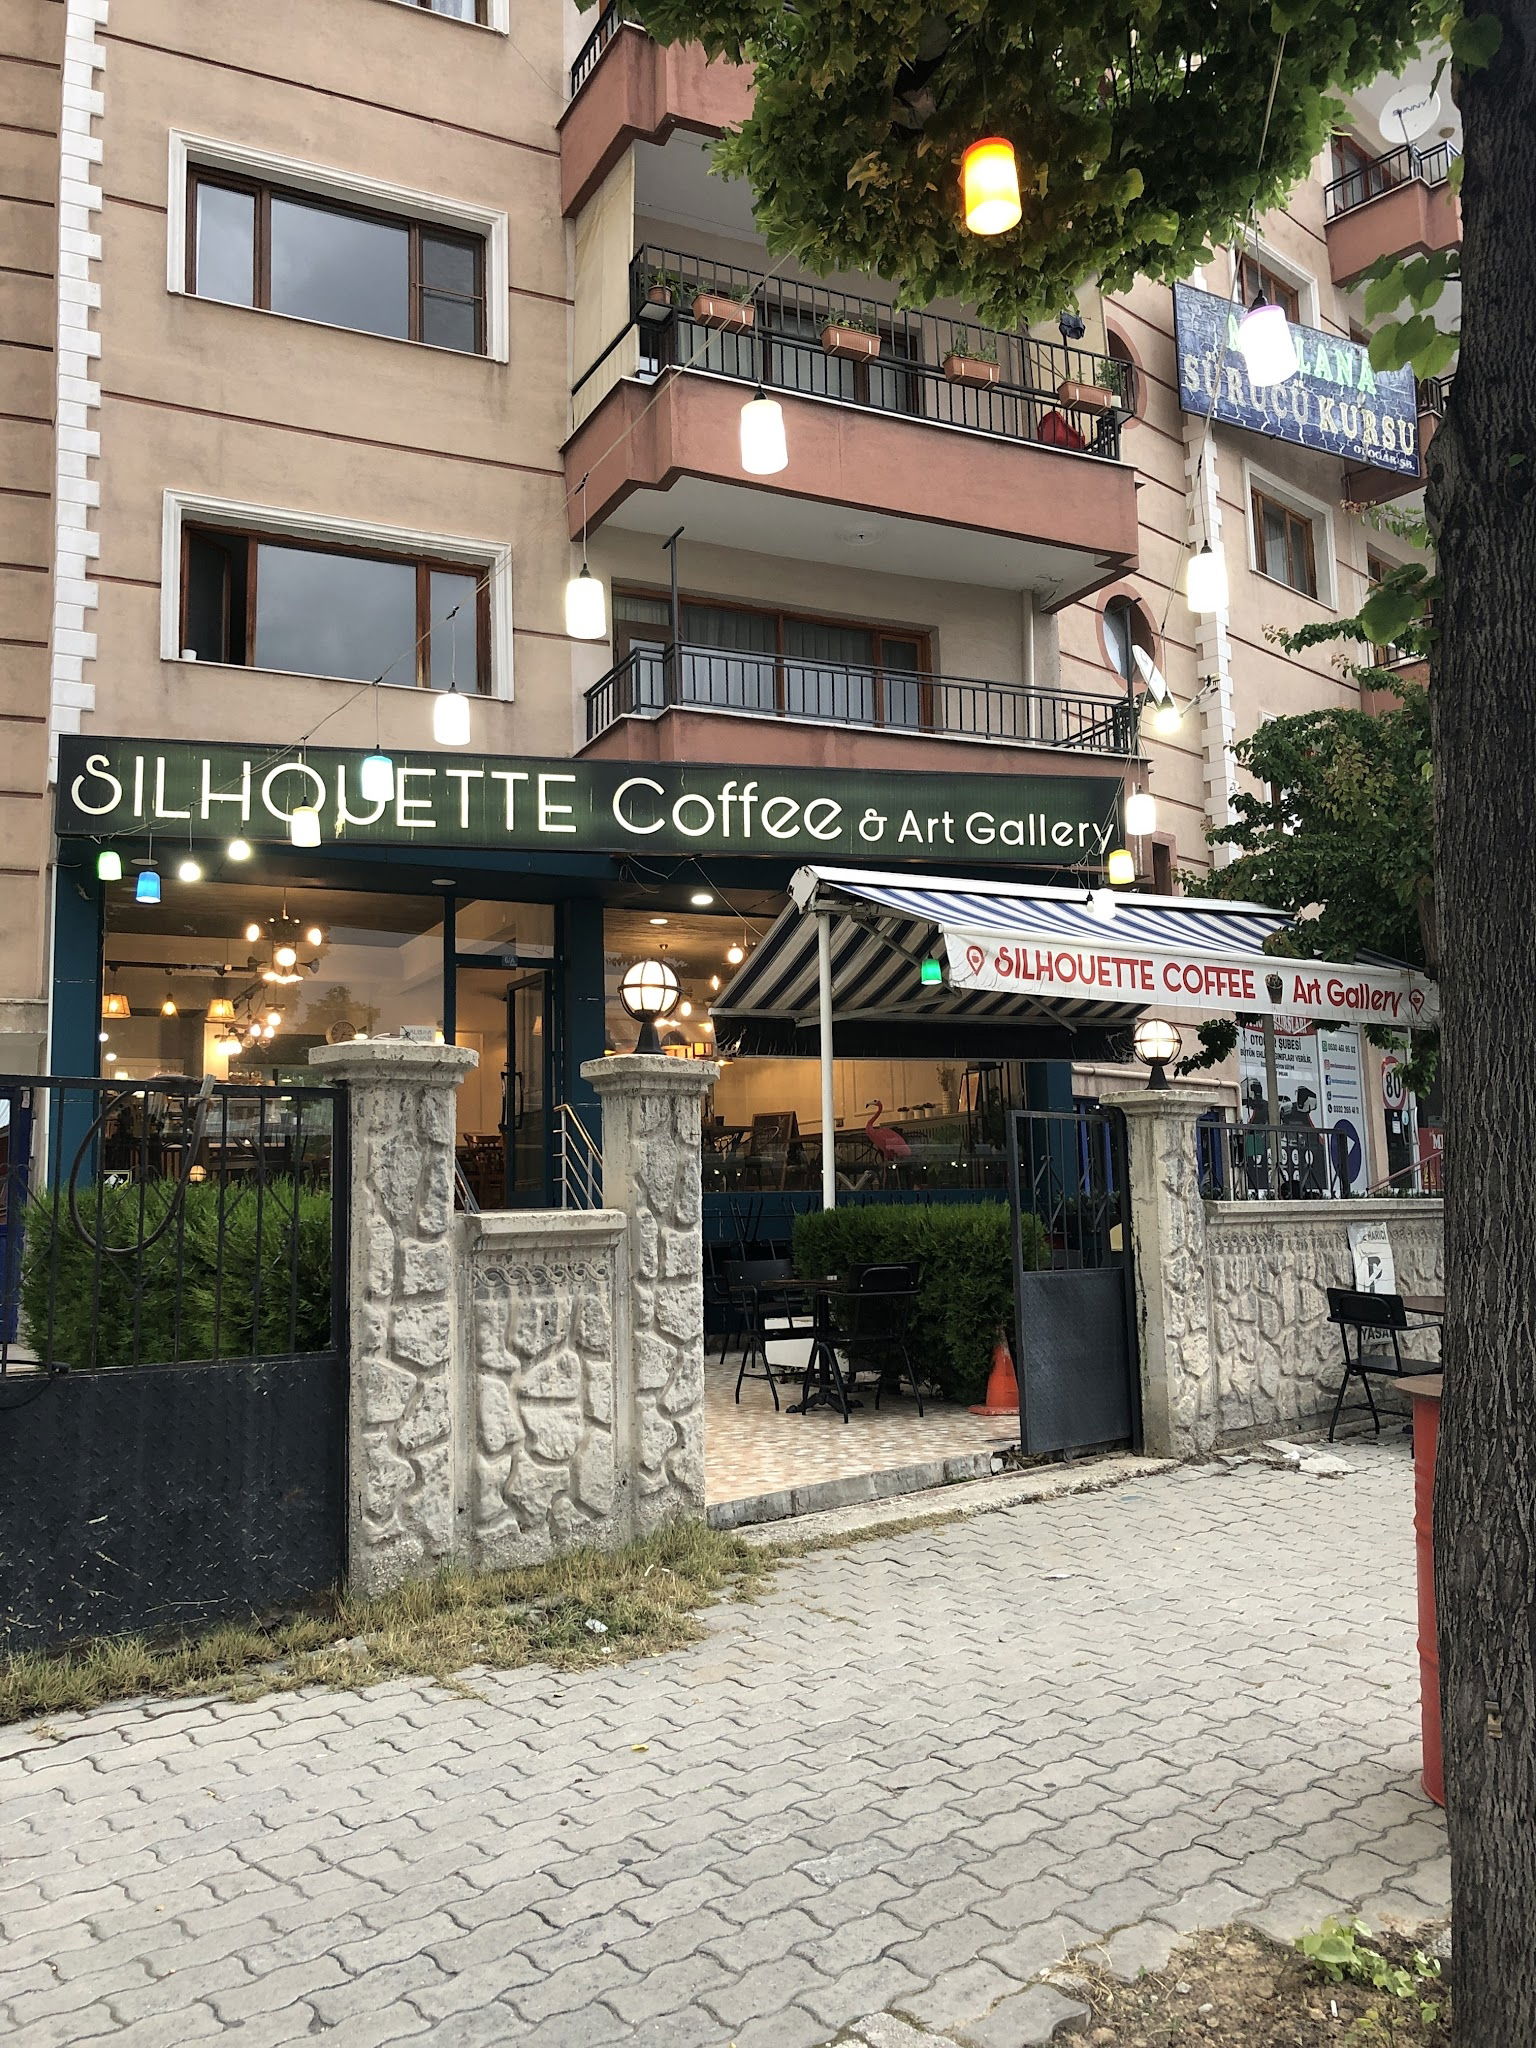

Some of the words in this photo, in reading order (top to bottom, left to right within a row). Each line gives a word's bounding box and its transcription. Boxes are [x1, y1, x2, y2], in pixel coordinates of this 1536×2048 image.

[1318, 394, 1415, 456] KURSU
[71, 754, 577, 833] SILHOUETTE
[612, 777, 843, 840] Coffee
[858, 808, 888, 842] &
[898, 809, 955, 844] Art
[965, 811, 1114, 854] Gallery
[994, 946, 1155, 990] SILHOUETTE
[1162, 962, 1256, 999] COFFEE
[1293, 975, 1322, 1005] Art
[1327, 979, 1402, 1017] Gallery
[1278, 1038, 1302, 1051] ŞUBESİ
[1386, 1071, 1401, 1098] 80
[1361, 1327, 1393, 1341] YASA
